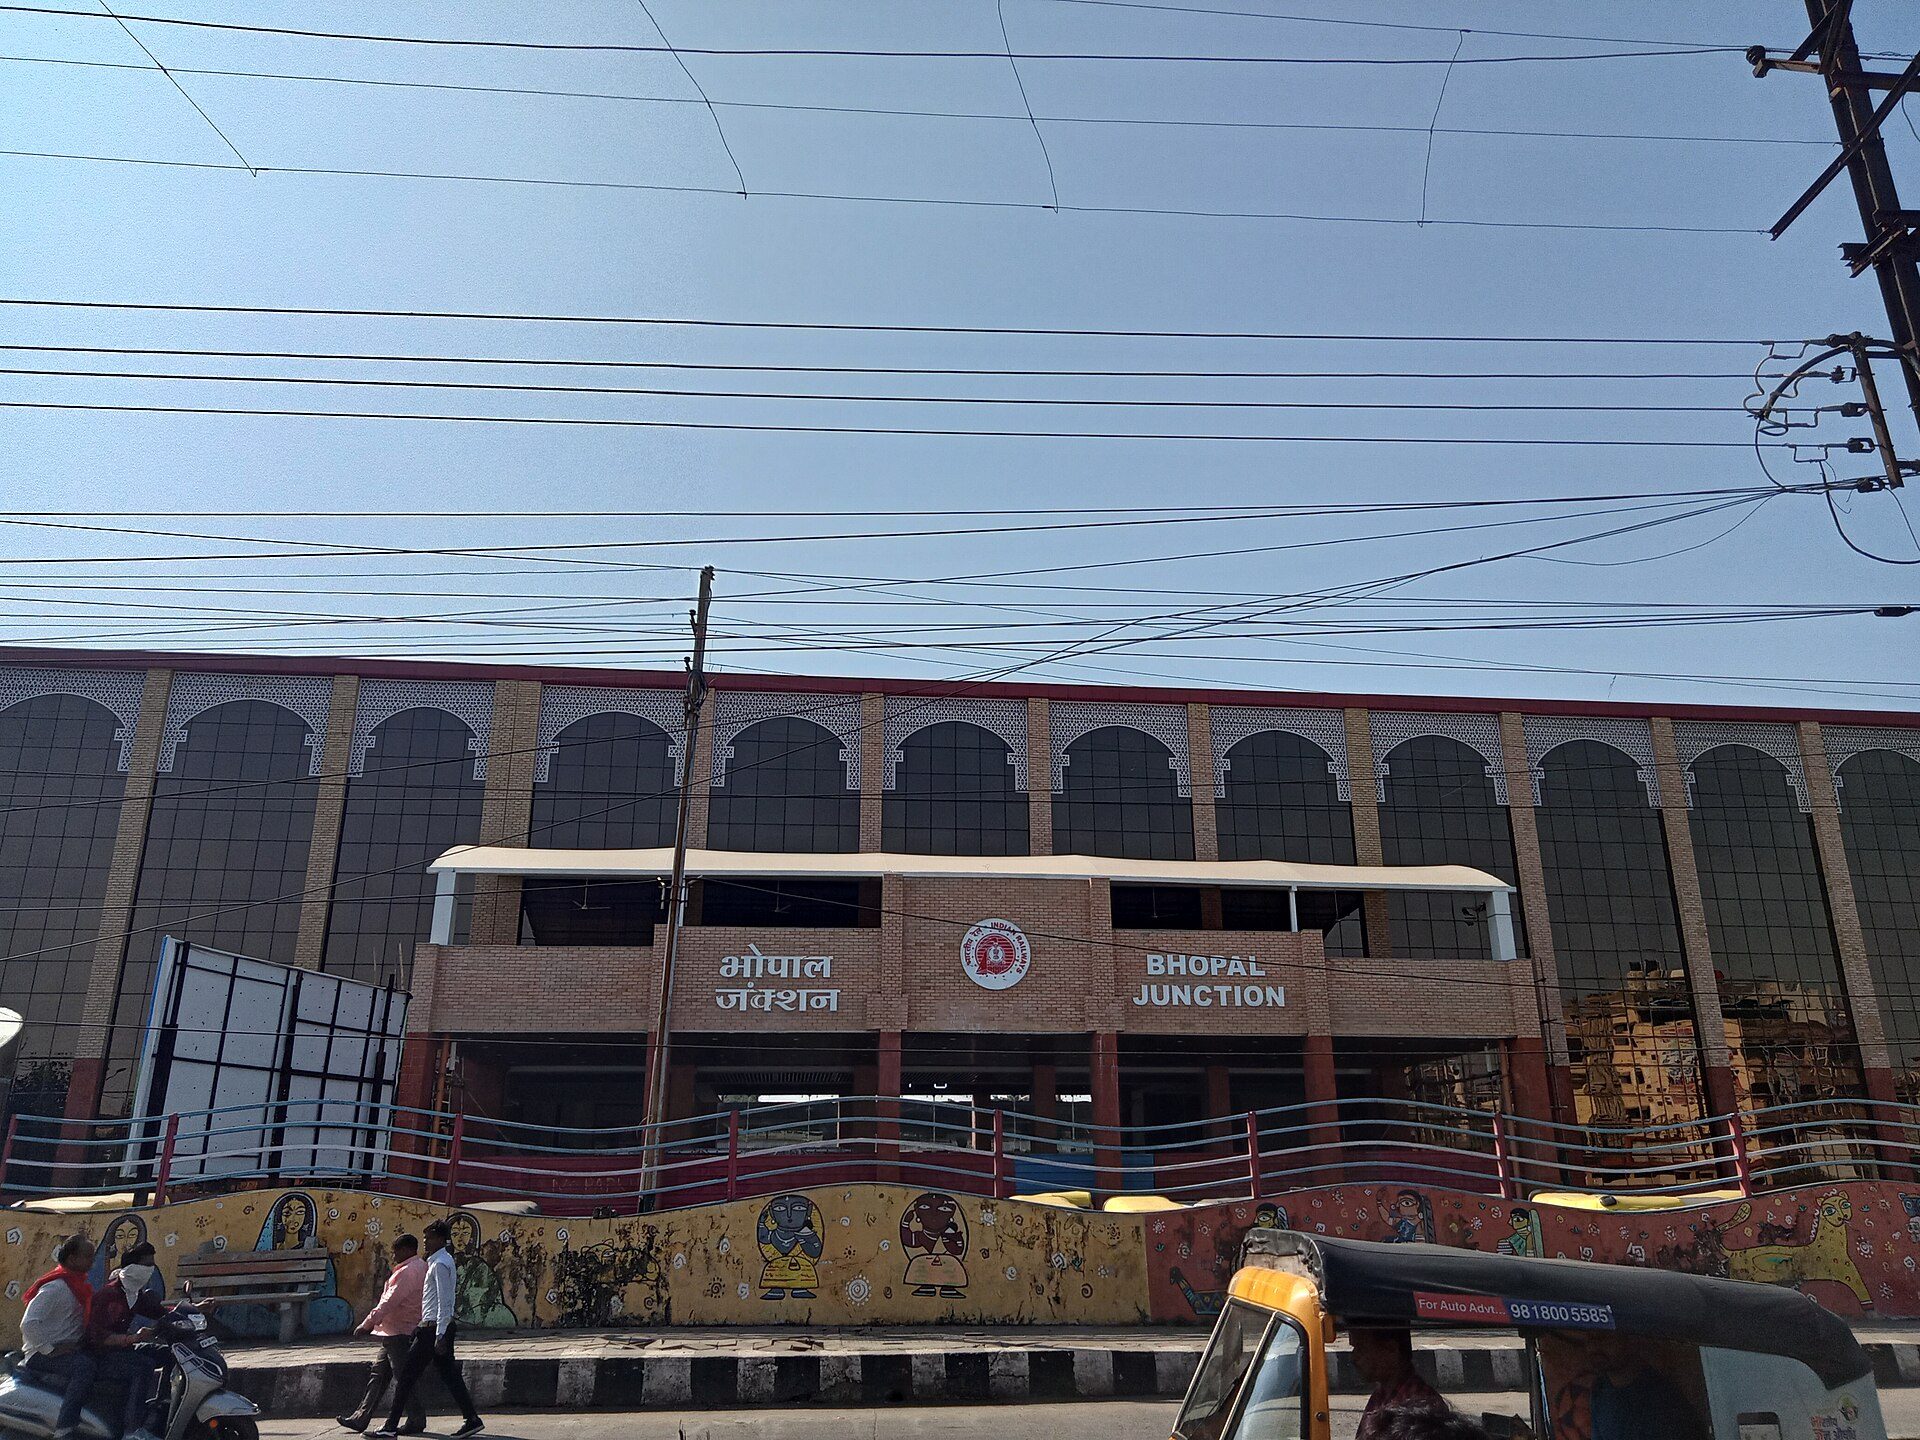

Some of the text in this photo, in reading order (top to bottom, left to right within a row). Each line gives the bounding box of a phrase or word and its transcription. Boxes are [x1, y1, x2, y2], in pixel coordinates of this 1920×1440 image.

[719, 943, 834, 978] भोपाल
[1016, 934, 1028, 974] RAILWAYS
[1147, 954, 1266, 977] BHOPAL
[715, 982, 841, 1012] जंक्शन
[1132, 984, 1285, 1007] JUNCTION
[1418, 1299, 1438, 1311] For
[1440, 1300, 1467, 1313] Auto
